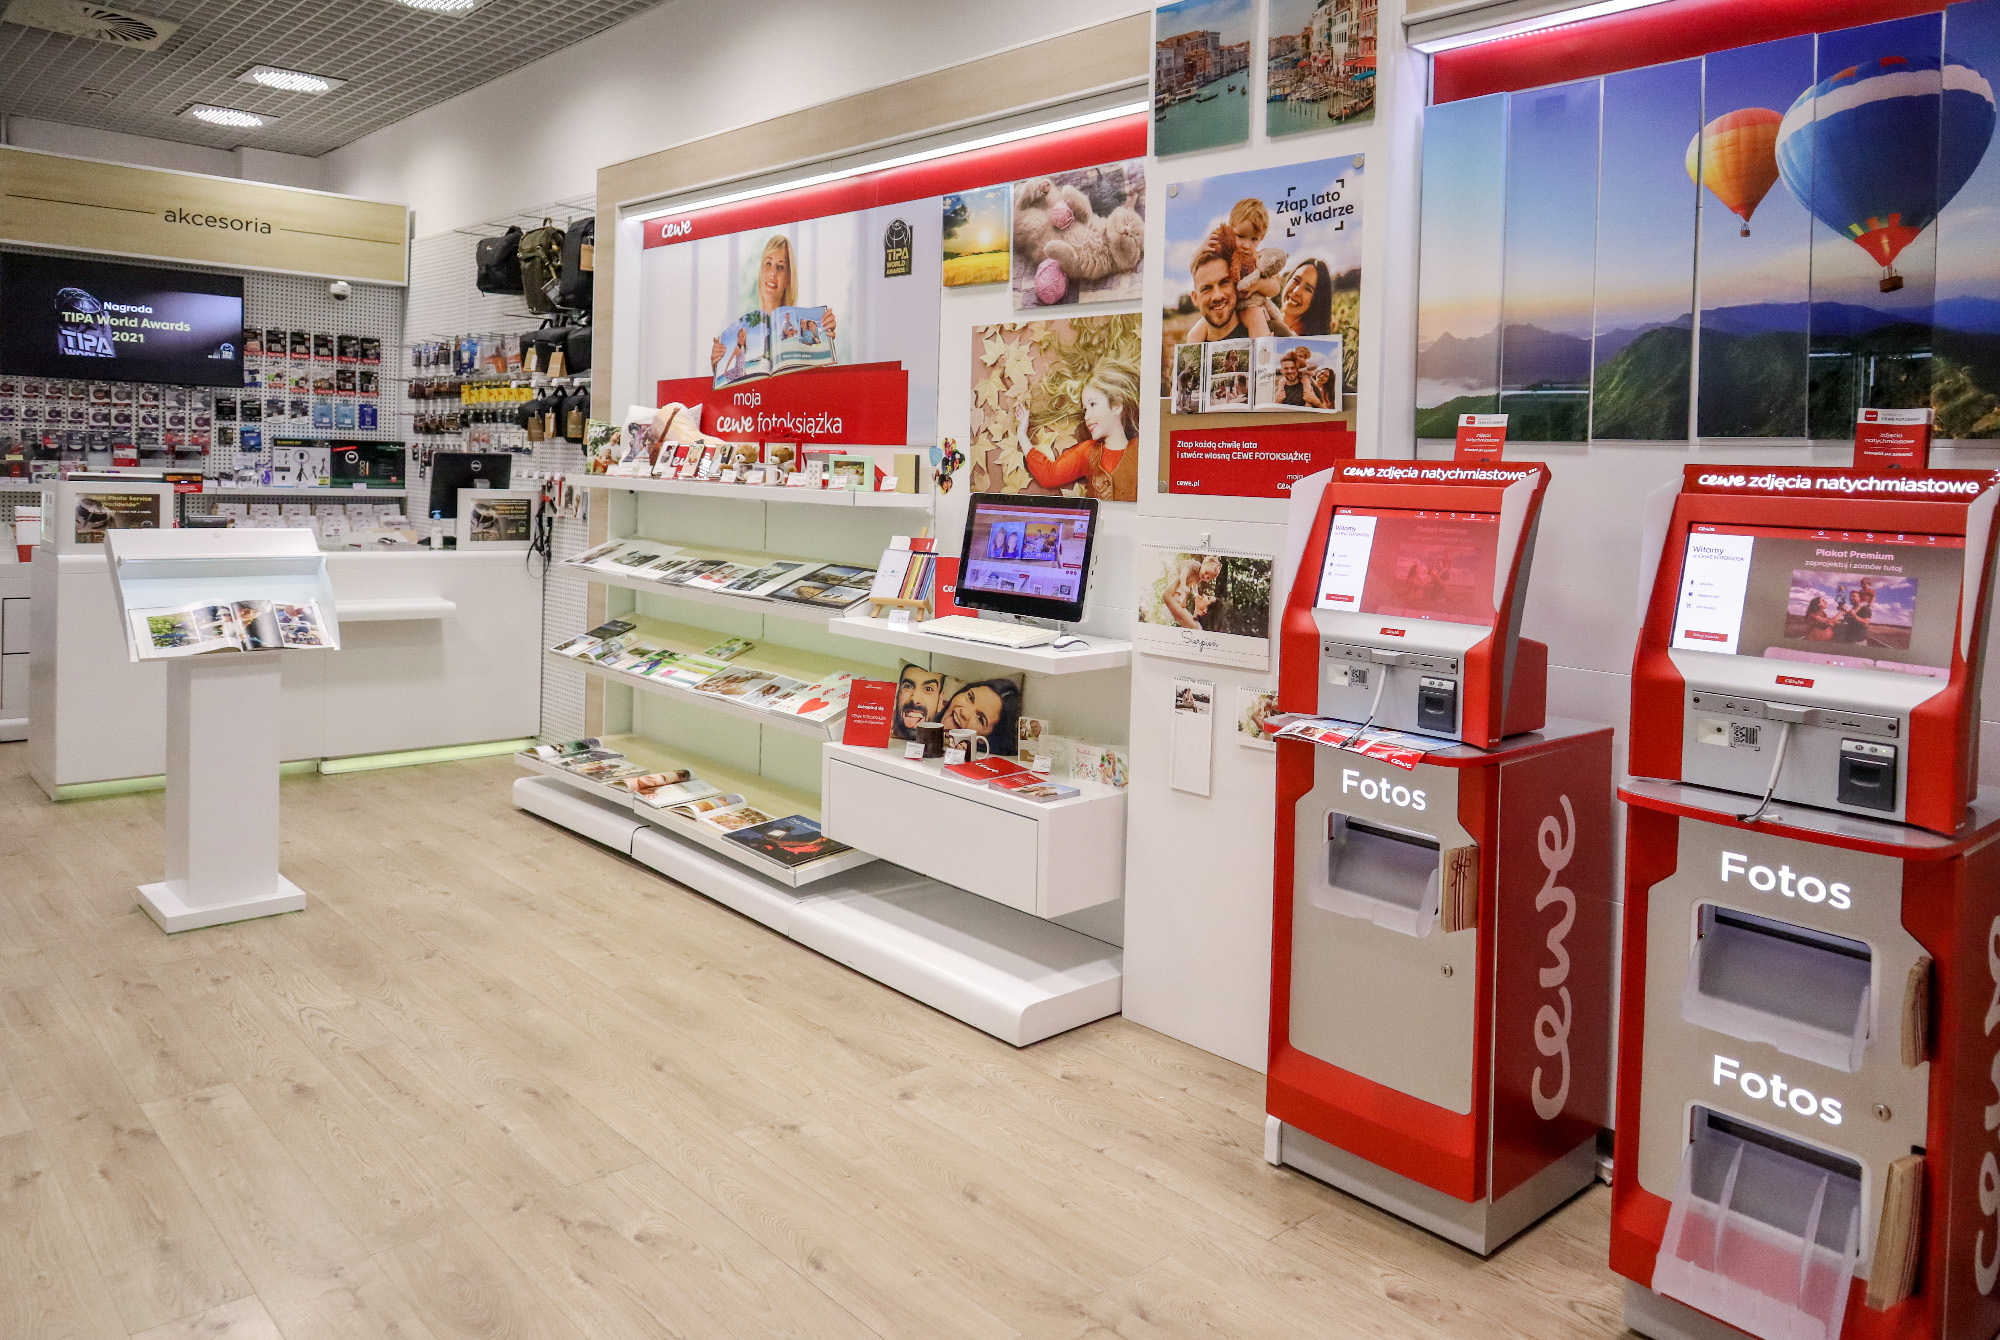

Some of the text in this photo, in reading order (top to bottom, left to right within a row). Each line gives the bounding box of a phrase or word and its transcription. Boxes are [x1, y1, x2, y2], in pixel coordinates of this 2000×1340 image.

[1276, 191, 1341, 214] Złap lato
[164, 207, 272, 235] akcesoria
[1290, 204, 1354, 226] w kadrze
[661, 219, 692, 238] cewe
[887, 248, 909, 261] TIPA
[886, 266, 905, 275] AWARDS
[887, 260, 906, 269] WORLD
[103, 301, 153, 314] Nagroda
[62, 311, 191, 332] TIPA World Awards
[61, 329, 113, 355] TIPA
[112, 331, 144, 343] 2021
[733, 389, 761, 408] moja
[716, 411, 842, 438] cewe fotoksiążka
[1177, 440, 1258, 450] Złap każdą chwilę lata
[1180, 451, 1204, 459] stwórz
[1204, 451, 1231, 461] własną
[1231, 452, 1254, 460] CEWE
[1254, 451, 1312, 463] FOTOKSIĄŻKĘ!
[1343, 465, 1527, 482] cewe zdjęcia natychmiastowe
[1176, 479, 1200, 487] cewe.pl
[1277, 482, 1293, 490] cew
[1697, 472, 1980, 494] cewe zdjęcia natychmiastowe
[1693, 546, 1724, 555] Witamy
[1815, 548, 1894, 561] Plakat Premium
[1805, 560, 1848, 570] zaprojektuj
[1853, 563, 1882, 571] zamów
[1883, 564, 1903, 573] tutaj
[1391, 758, 1412, 768] cewe
[1342, 768, 1426, 811] Fotos
[1721, 851, 1852, 910] Fotos
[1531, 794, 1576, 1120] cewe
[1713, 1054, 1843, 1126] Fotos
